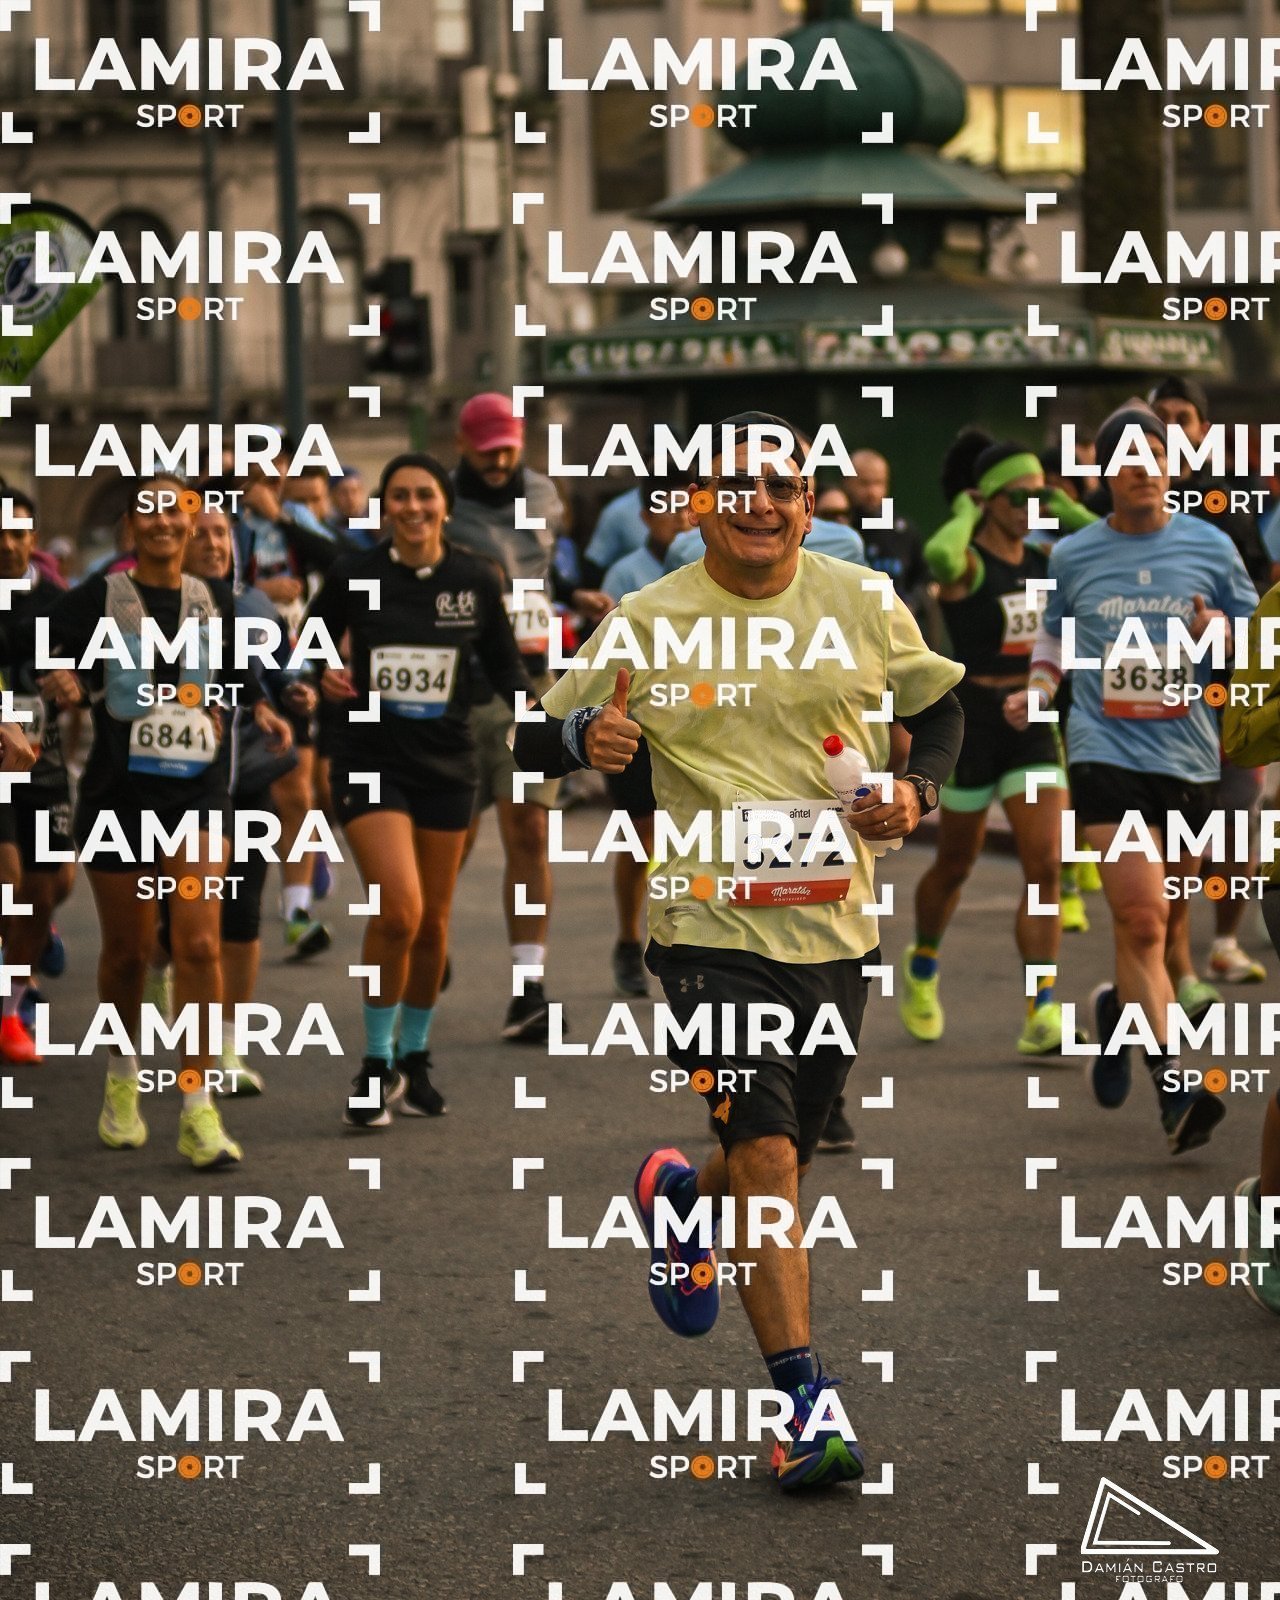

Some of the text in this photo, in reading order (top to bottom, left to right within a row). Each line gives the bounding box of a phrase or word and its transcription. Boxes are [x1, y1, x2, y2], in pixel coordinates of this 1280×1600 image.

[376, 666, 447, 693] 6934
[1110, 665, 1188, 692] 3638
[137, 723, 207, 752] 6841
